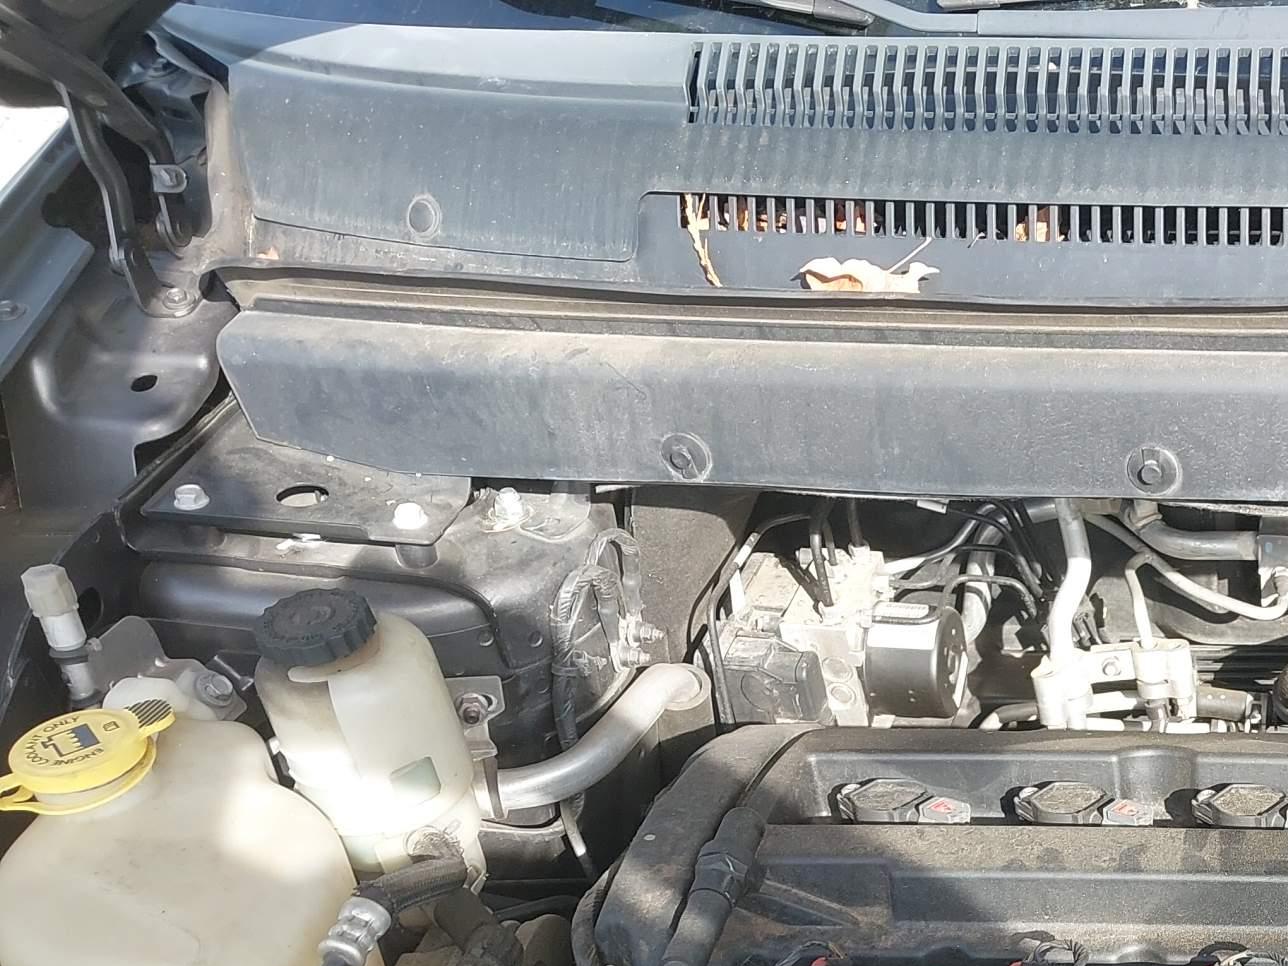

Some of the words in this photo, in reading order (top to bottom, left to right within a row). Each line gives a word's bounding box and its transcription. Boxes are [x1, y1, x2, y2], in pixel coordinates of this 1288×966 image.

[42, 715, 80, 732] ONLY
[24, 733, 50, 766] COOLANT
[50, 747, 105, 767] ENGINE
